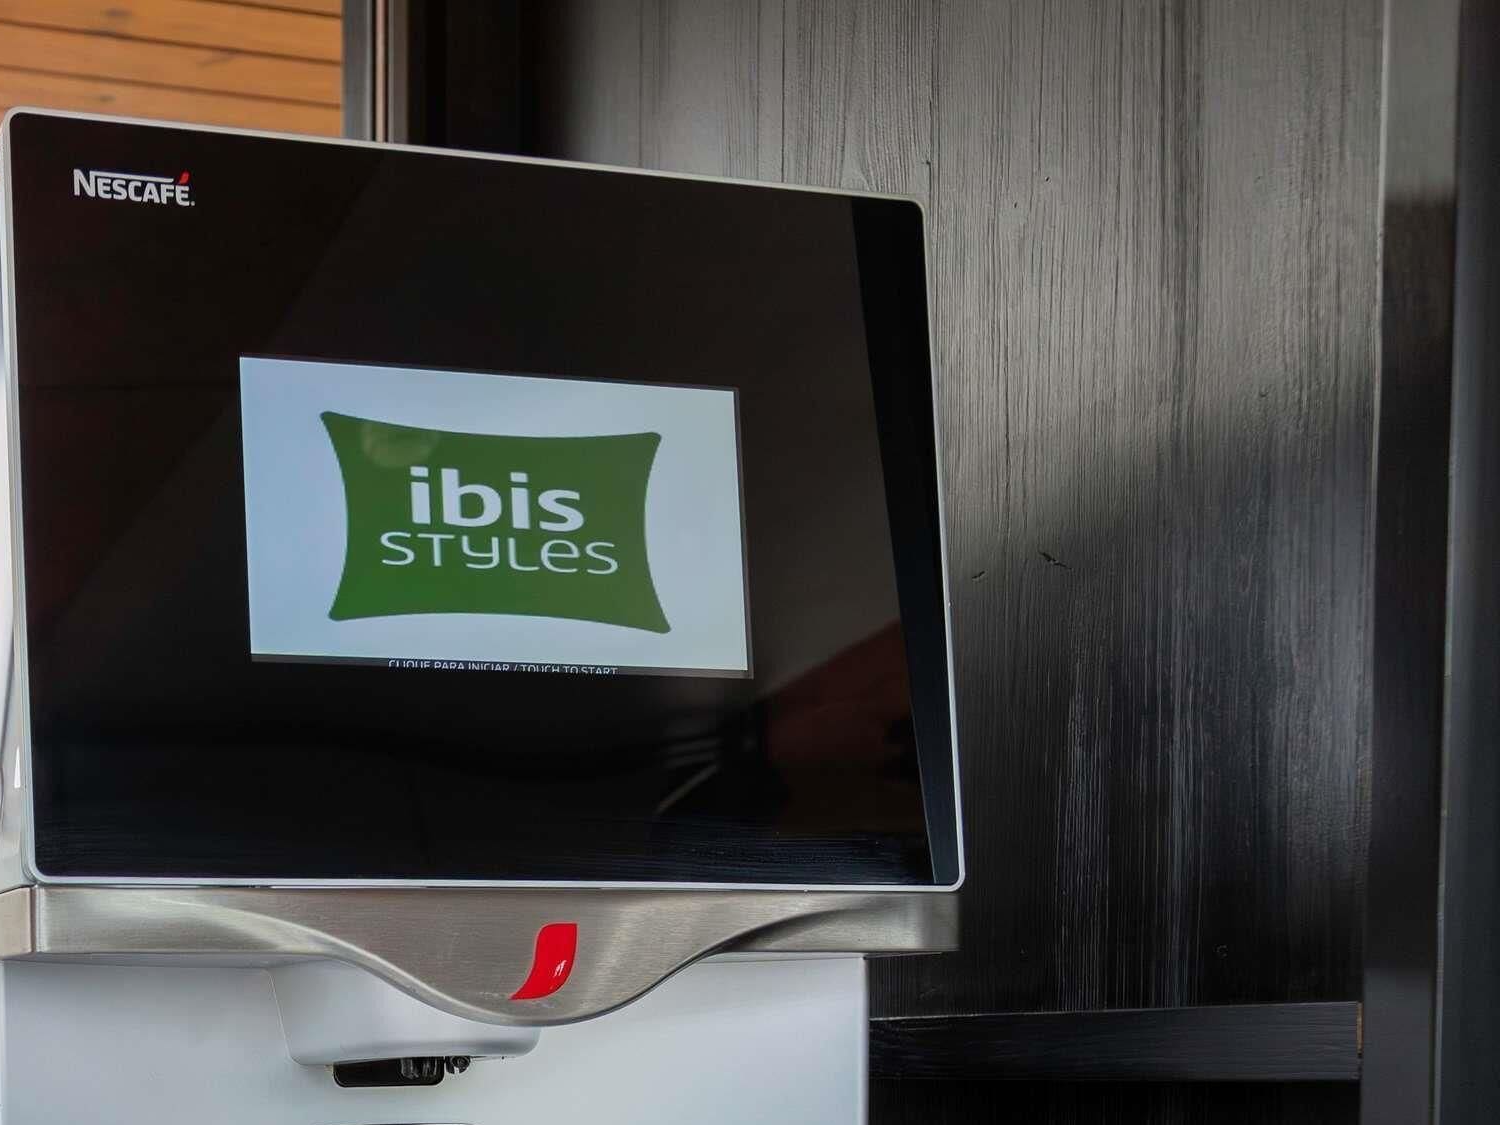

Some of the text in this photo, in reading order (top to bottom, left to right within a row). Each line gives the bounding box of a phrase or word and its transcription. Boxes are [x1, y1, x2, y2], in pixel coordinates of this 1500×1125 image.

[409, 465, 585, 532] ibis
[434, 660, 466, 670] PARA
[563, 665, 579, 675] TO
[581, 666, 619, 675] START
